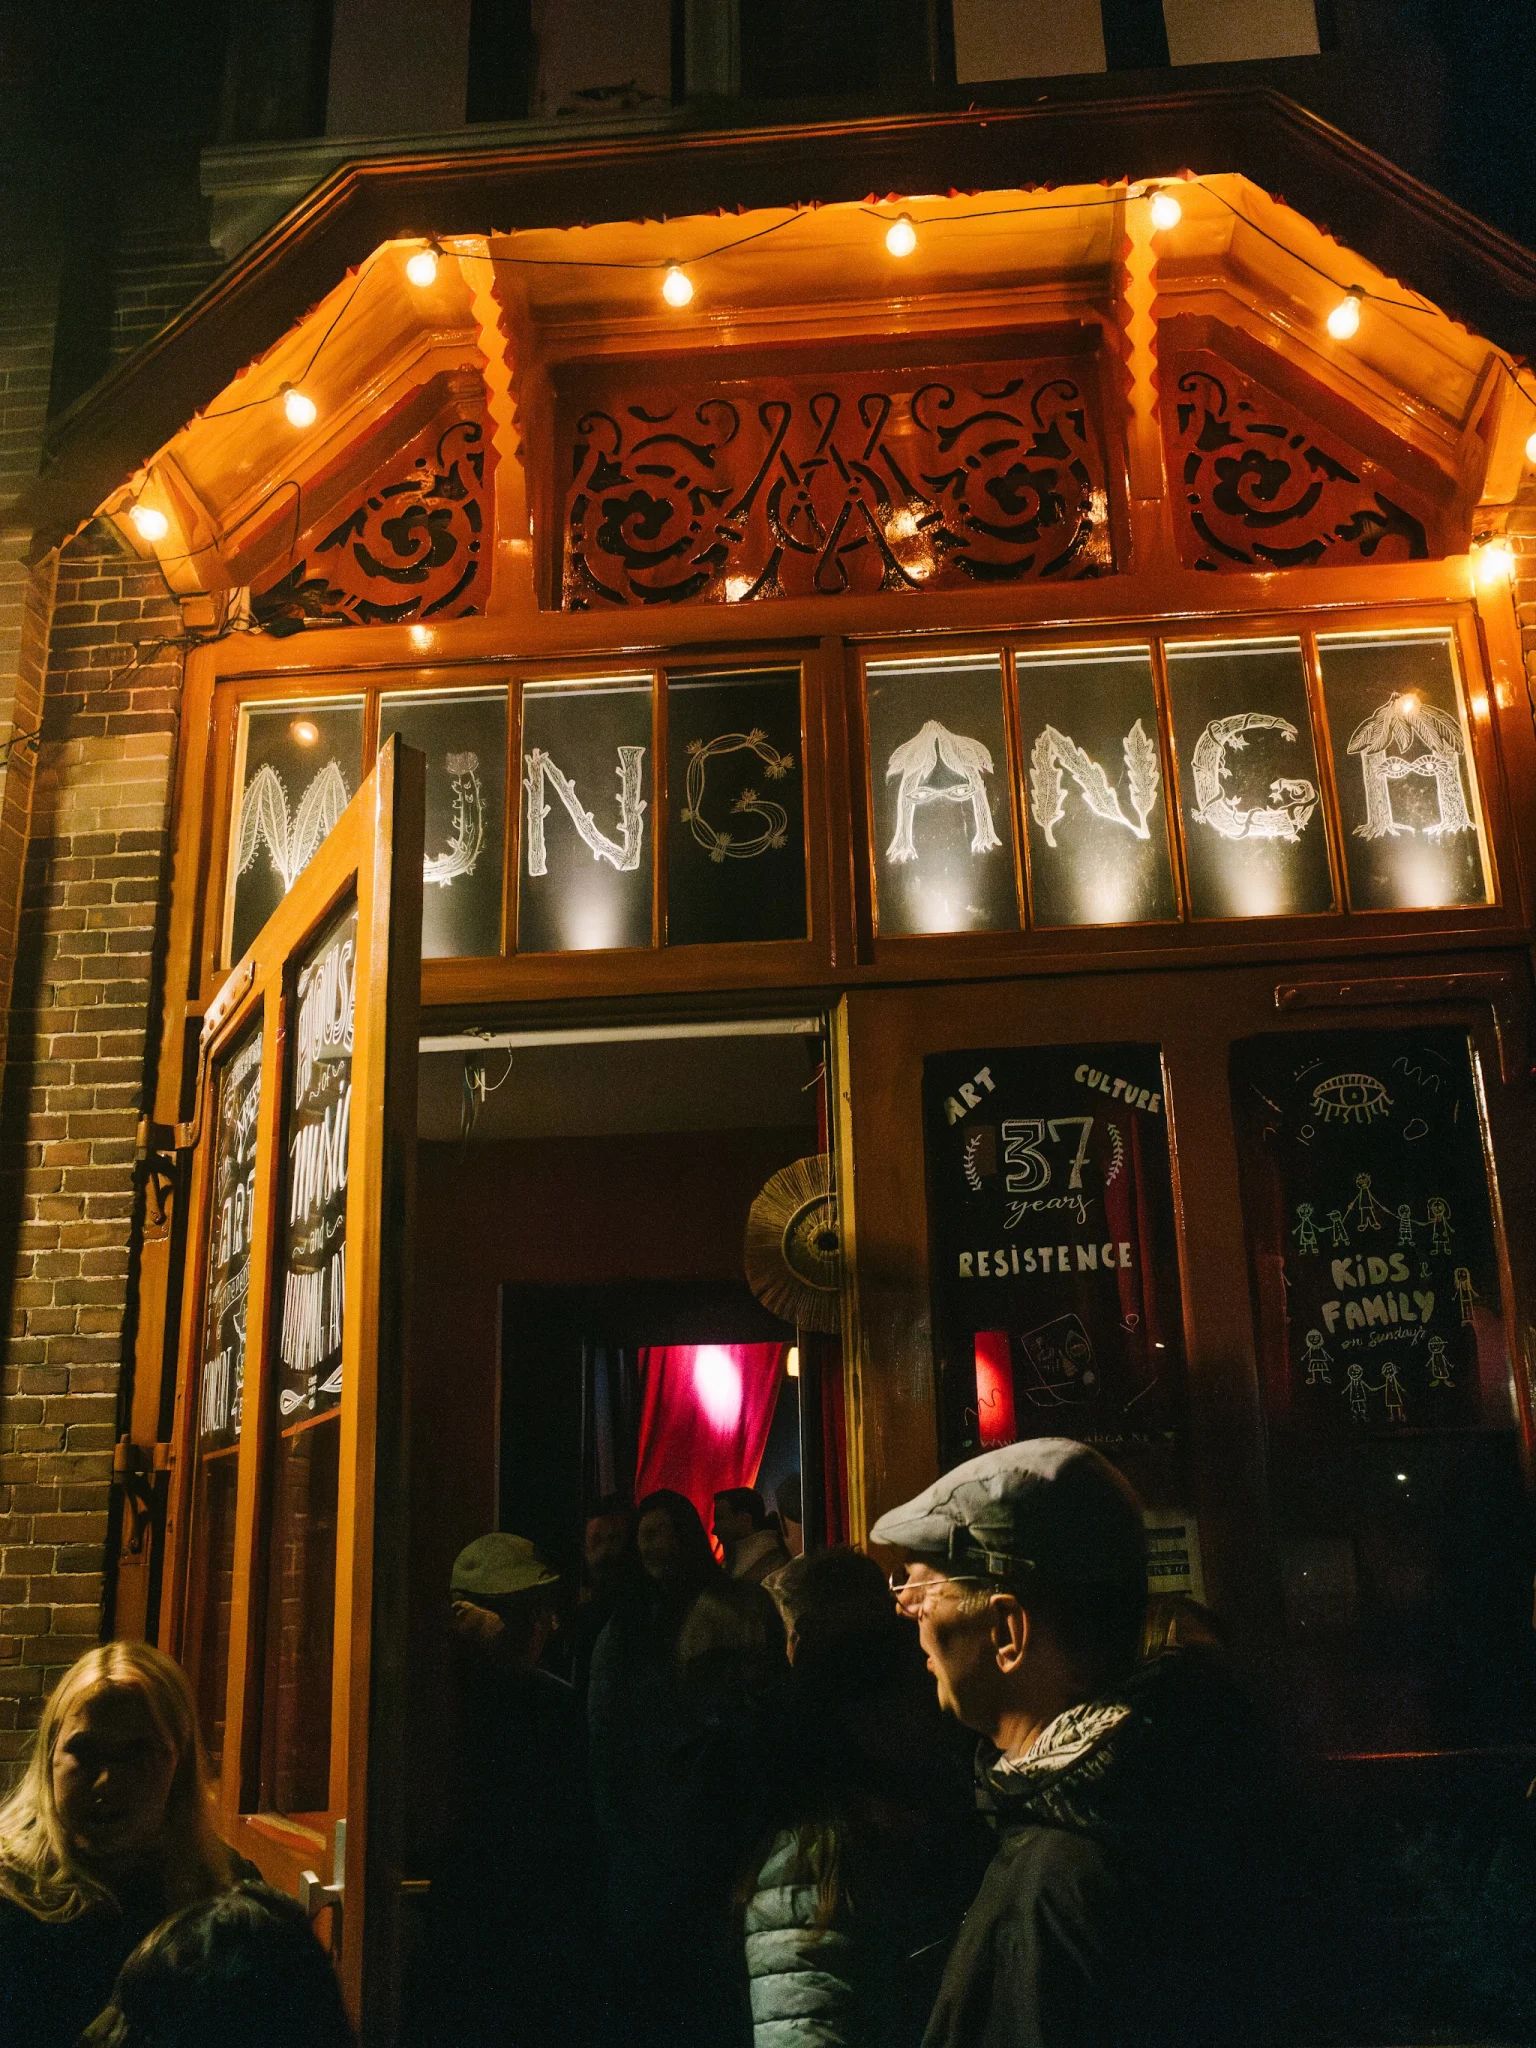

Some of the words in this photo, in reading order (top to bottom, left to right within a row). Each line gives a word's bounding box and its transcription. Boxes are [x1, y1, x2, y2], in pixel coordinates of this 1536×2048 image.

[944, 1066, 996, 1126] ART
[1074, 1064, 1161, 1113] CULTURE
[1002, 1116, 1094, 1192] 37
[1003, 1194, 1095, 1230] years
